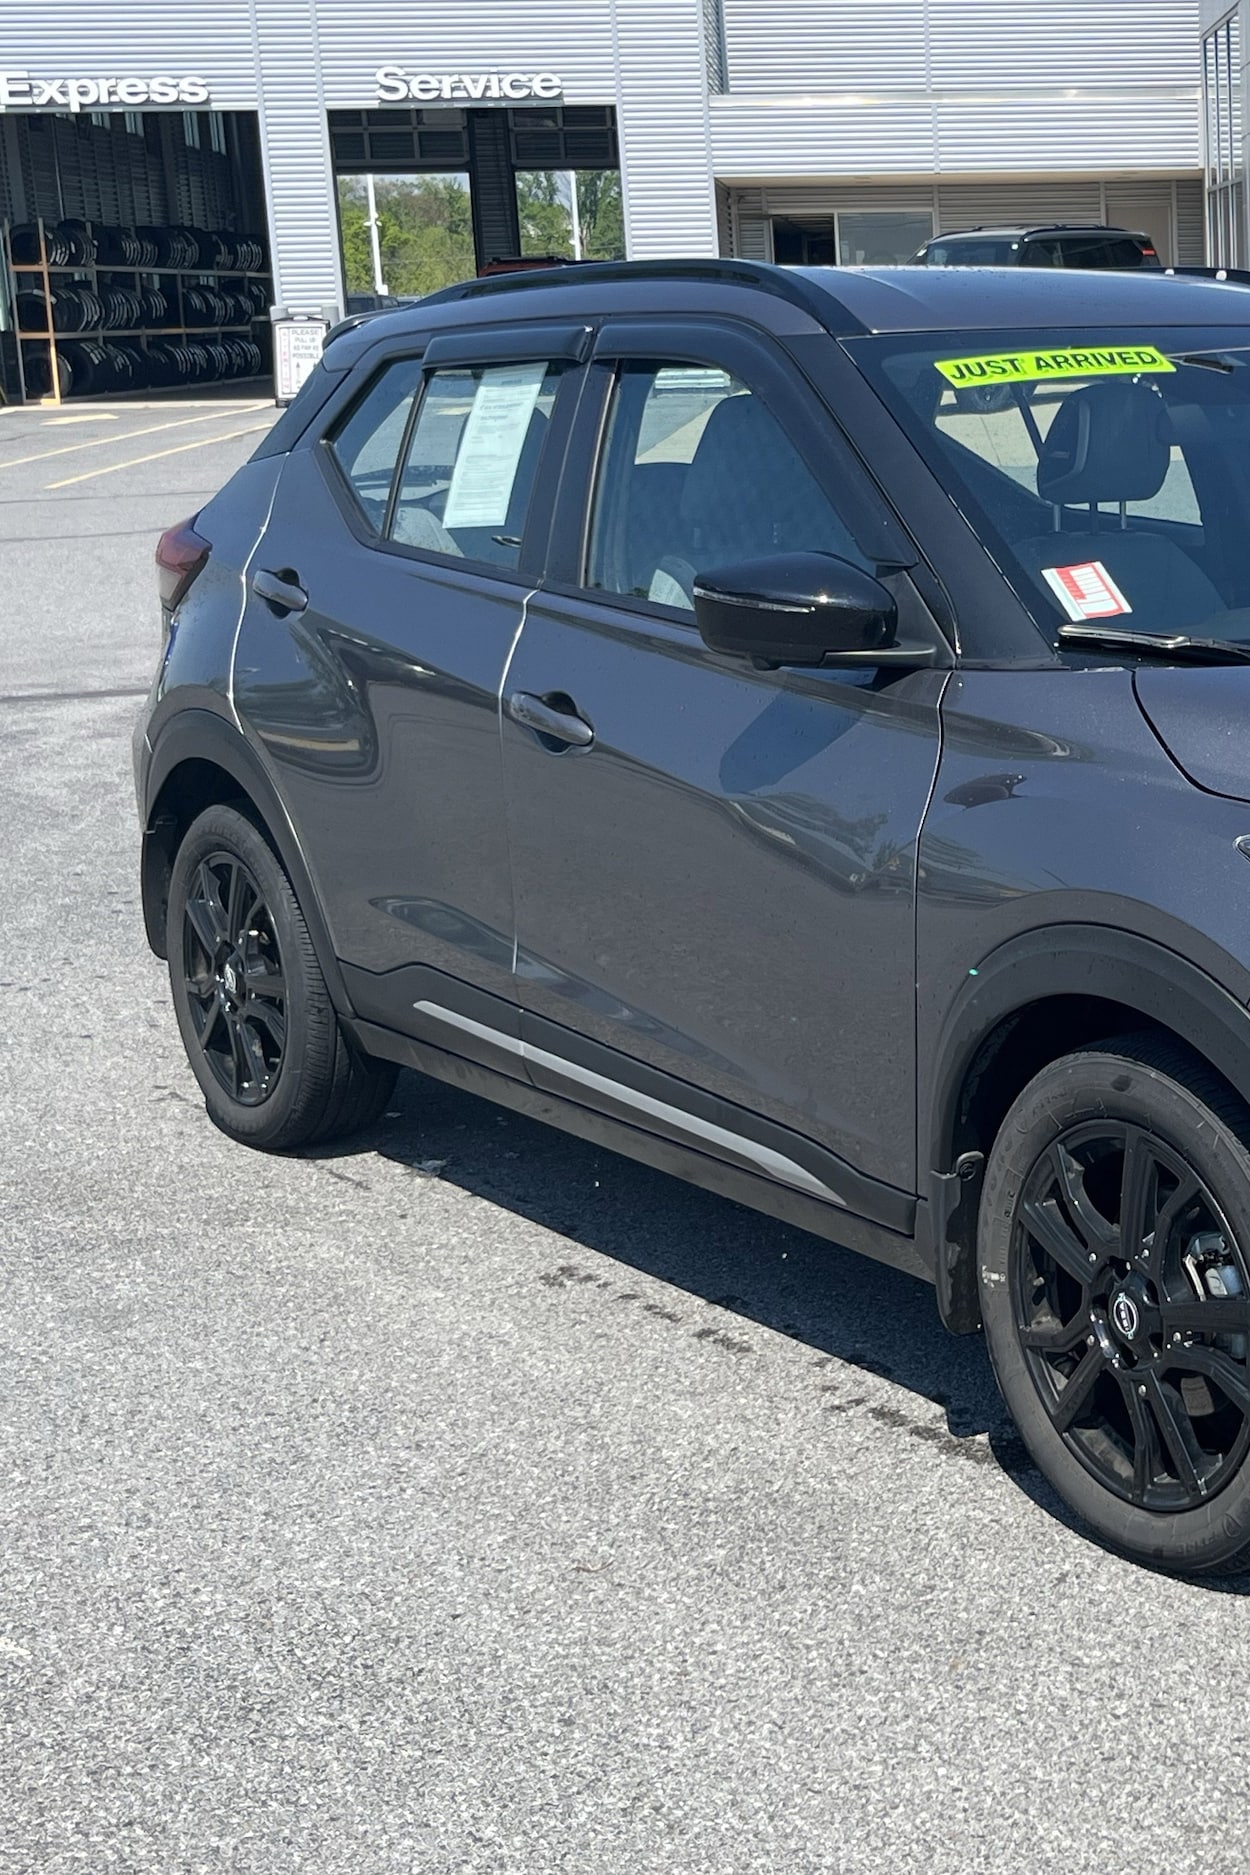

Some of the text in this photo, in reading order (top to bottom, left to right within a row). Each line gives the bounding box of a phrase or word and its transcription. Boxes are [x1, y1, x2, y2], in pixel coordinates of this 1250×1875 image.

[0, 71, 210, 112] Express
[376, 66, 562, 101] Service
[950, 350, 1162, 381] JUST ARRIVED
